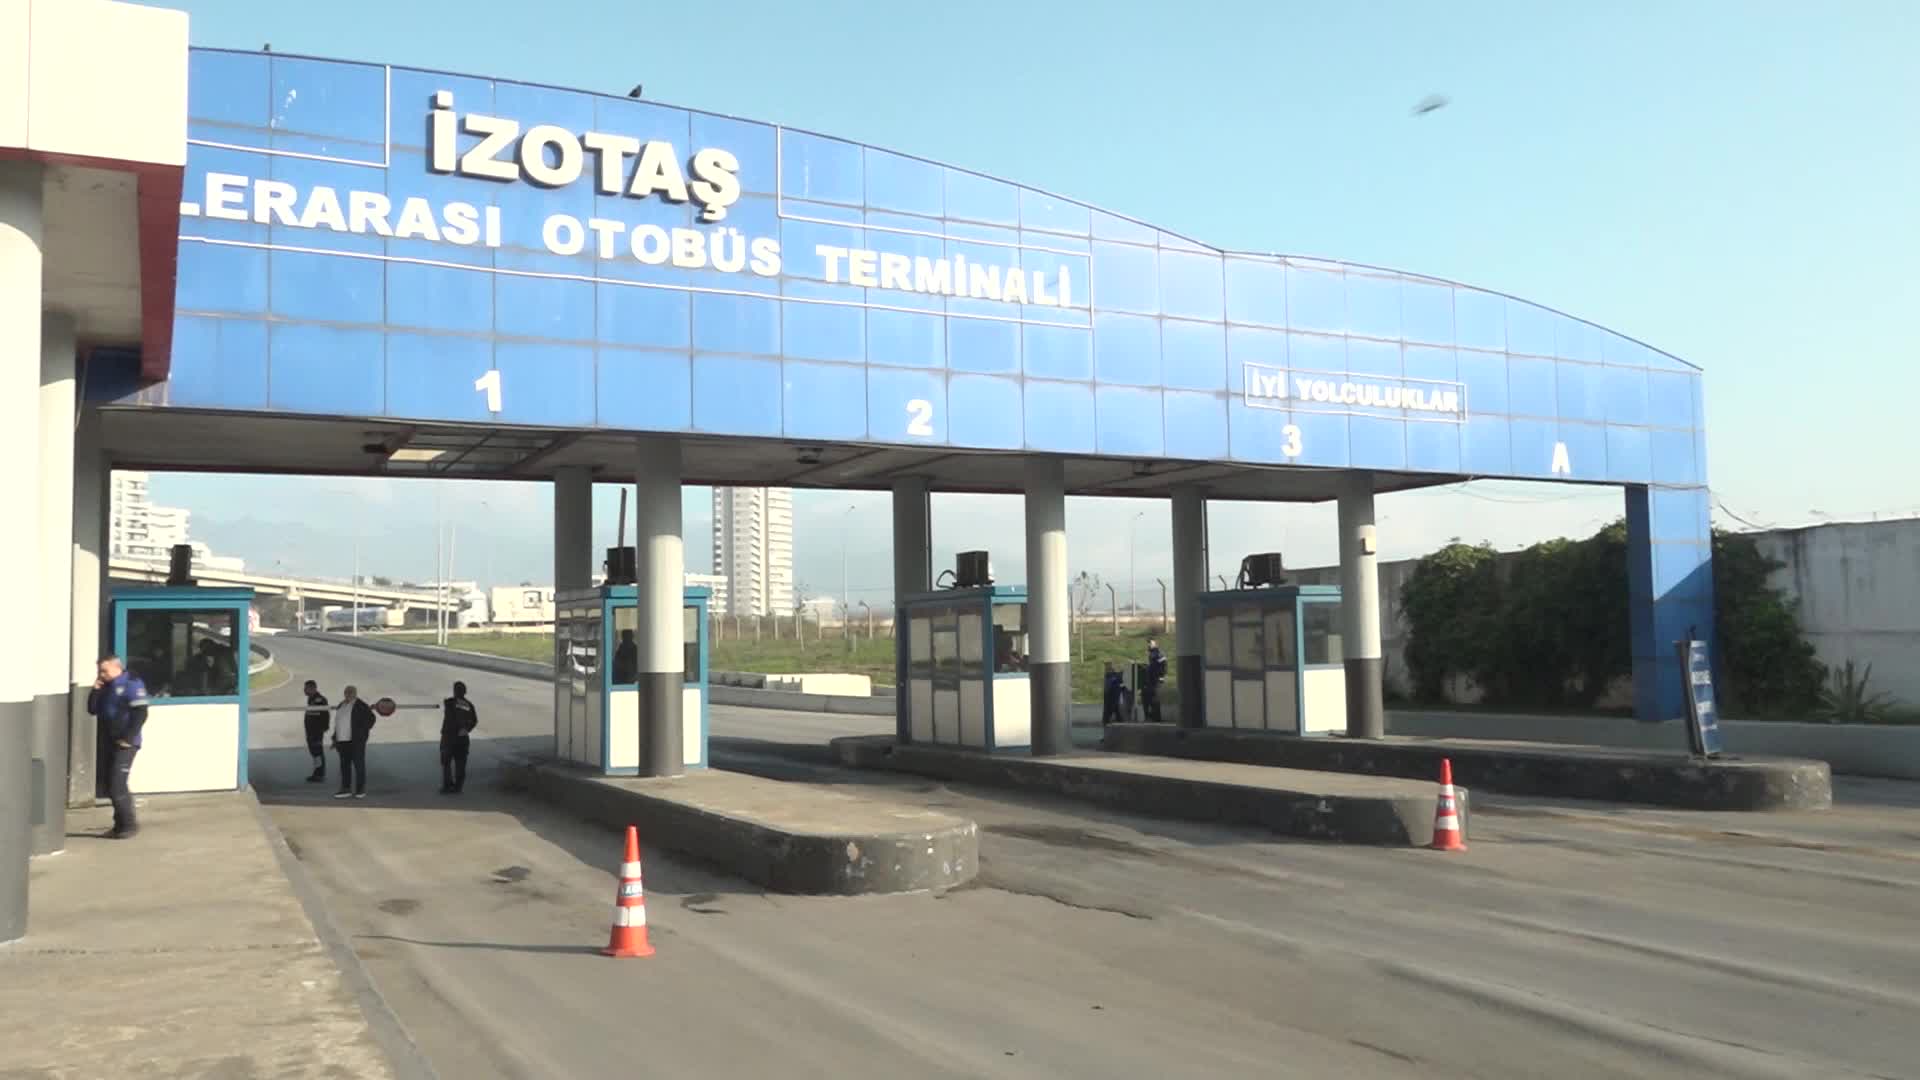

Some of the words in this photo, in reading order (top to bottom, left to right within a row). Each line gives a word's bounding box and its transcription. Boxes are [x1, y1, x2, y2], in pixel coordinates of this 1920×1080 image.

[428, 90, 742, 221] İZOTAŞ
[542, 215, 782, 276] OTOBÜS
[816, 245, 1071, 306] TERMİNALİ
[475, 371, 502, 412] 1
[1252, 369, 1287, 398] İYİ
[1296, 378, 1458, 412] YOLCULUKLAR
[906, 399, 934, 436] 2
[1281, 424, 1303, 456] 3
